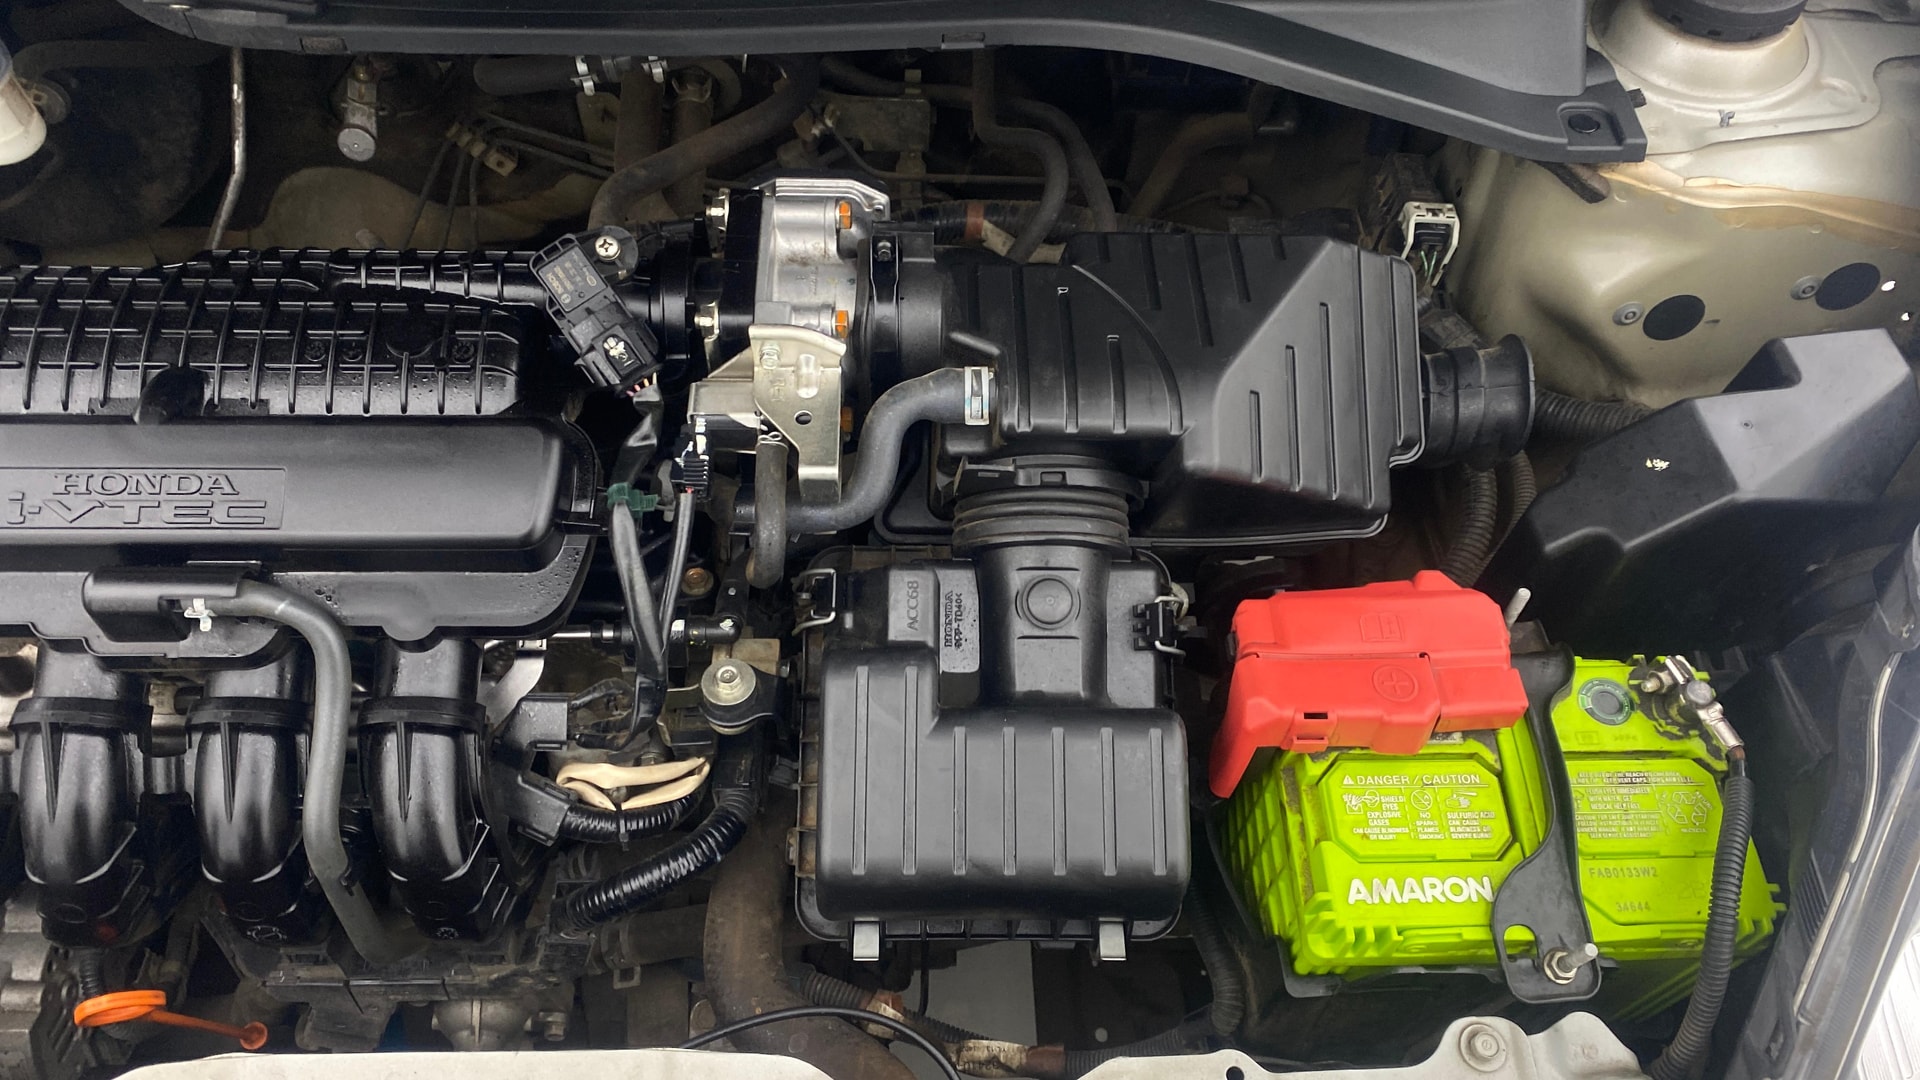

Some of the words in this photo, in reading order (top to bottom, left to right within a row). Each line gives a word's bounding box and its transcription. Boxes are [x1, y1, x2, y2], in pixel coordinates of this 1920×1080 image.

[52, 472, 240, 496] HONDA
[6, 490, 267, 525] i-VTEC
[906, 580, 919, 631] ACC68
[944, 590, 953, 648] HONDA
[1356, 775, 1410, 785] DANGER
[1422, 774, 1481, 785] CAUTION
[1367, 811, 1402, 819] EXPLOSIVE
[1382, 803, 1399, 811] EYES
[1419, 811, 1431, 819] NO
[1588, 866, 1659, 879] FAB0133W2
[1348, 877, 1495, 905] AMARON
